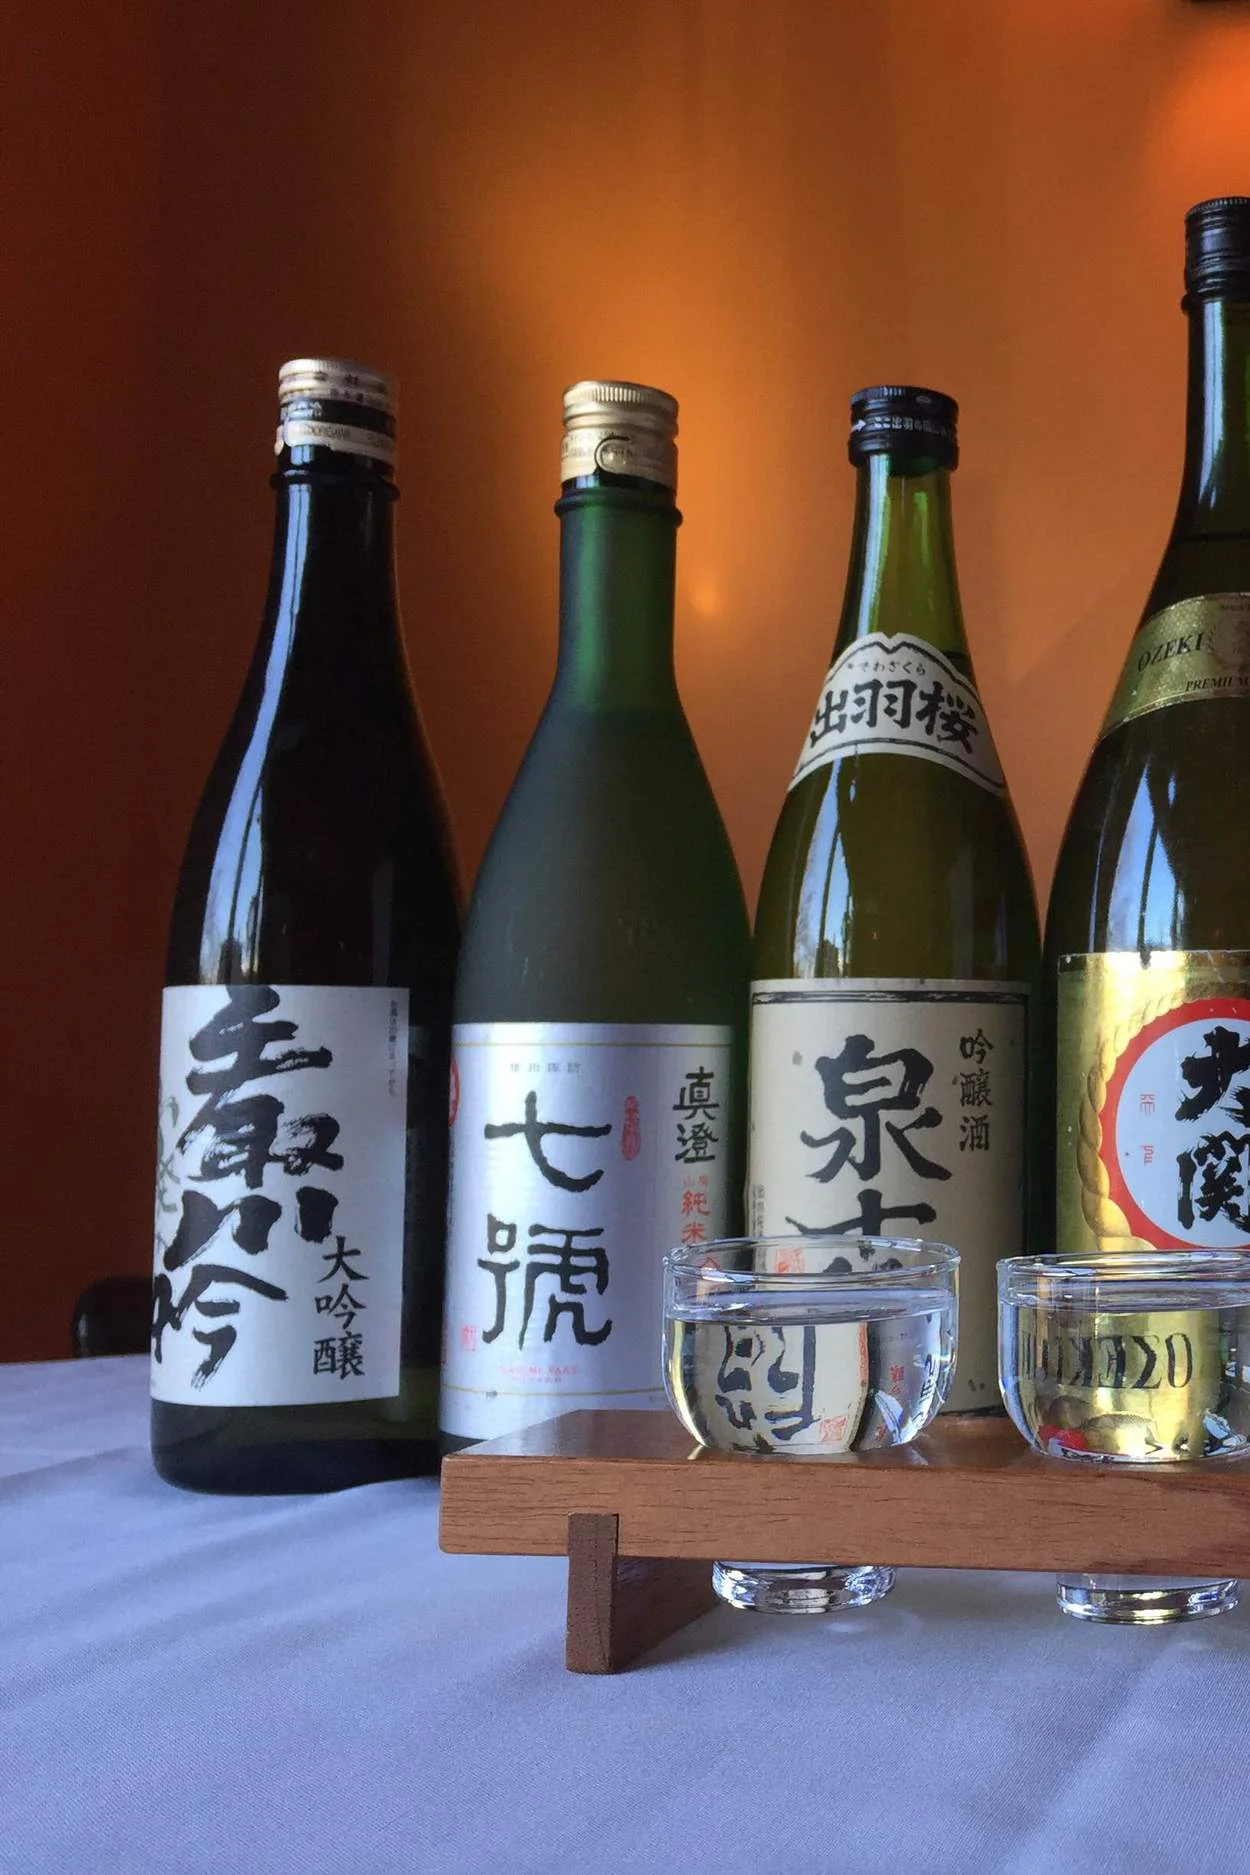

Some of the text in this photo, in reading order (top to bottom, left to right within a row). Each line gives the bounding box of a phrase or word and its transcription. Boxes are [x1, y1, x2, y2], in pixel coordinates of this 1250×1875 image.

[1137, 632, 1203, 672] OZEKI
[1186, 675, 1247, 691] PREMIUM
[810, 678, 978, 754] 出羽桜
[672, 1065, 721, 1165] 真澄
[312, 1235, 370, 1381] 大吟醸
